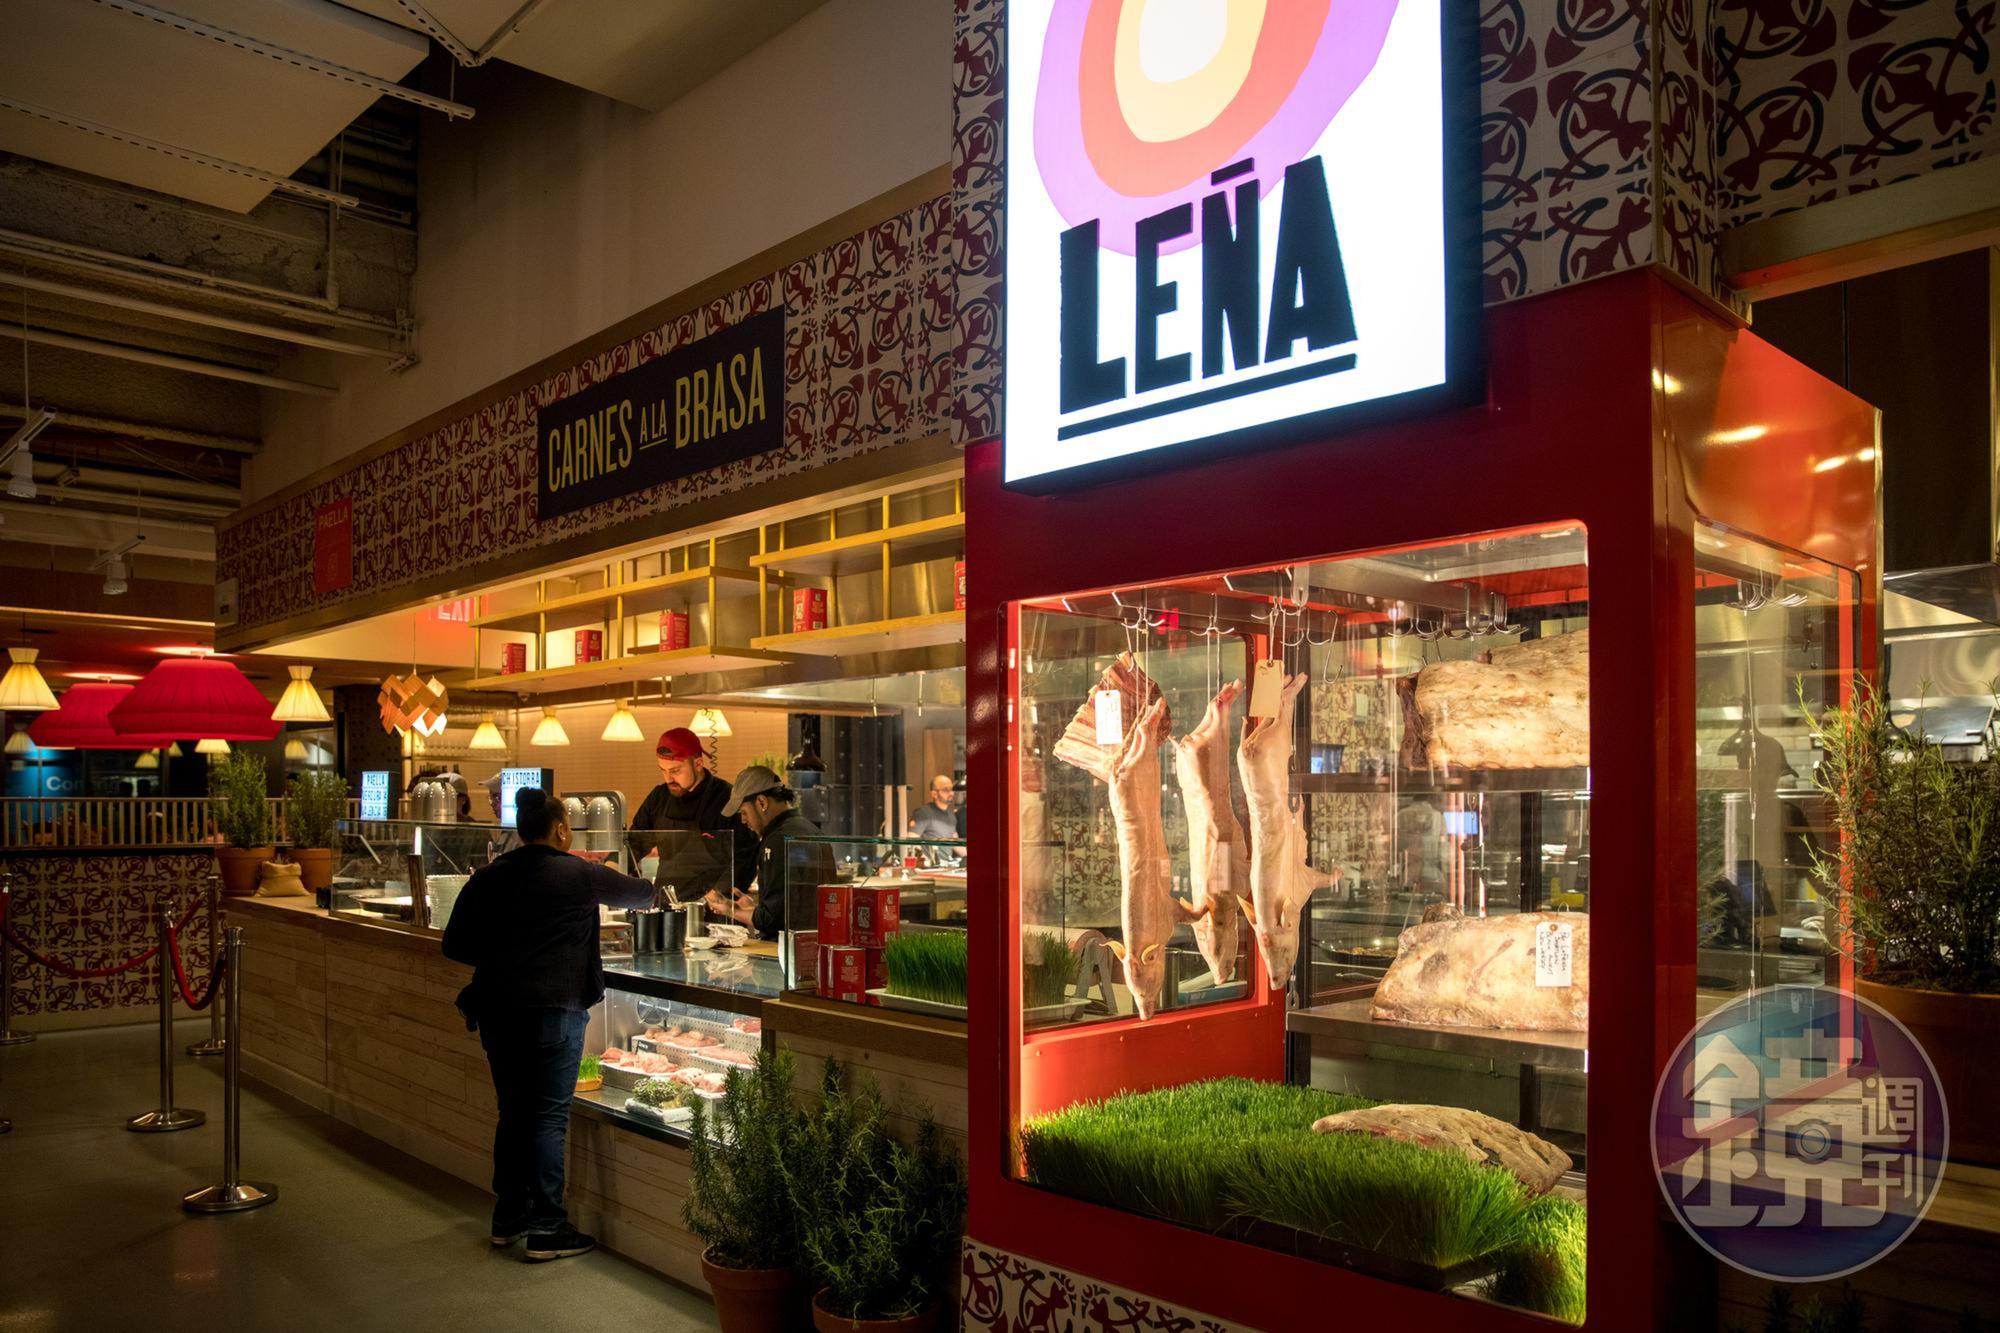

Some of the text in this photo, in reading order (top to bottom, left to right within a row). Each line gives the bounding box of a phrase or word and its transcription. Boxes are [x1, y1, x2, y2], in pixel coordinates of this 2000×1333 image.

[1060, 154, 1358, 415] LEÑA
[549, 347, 766, 493] CARNES A LA BRASA
